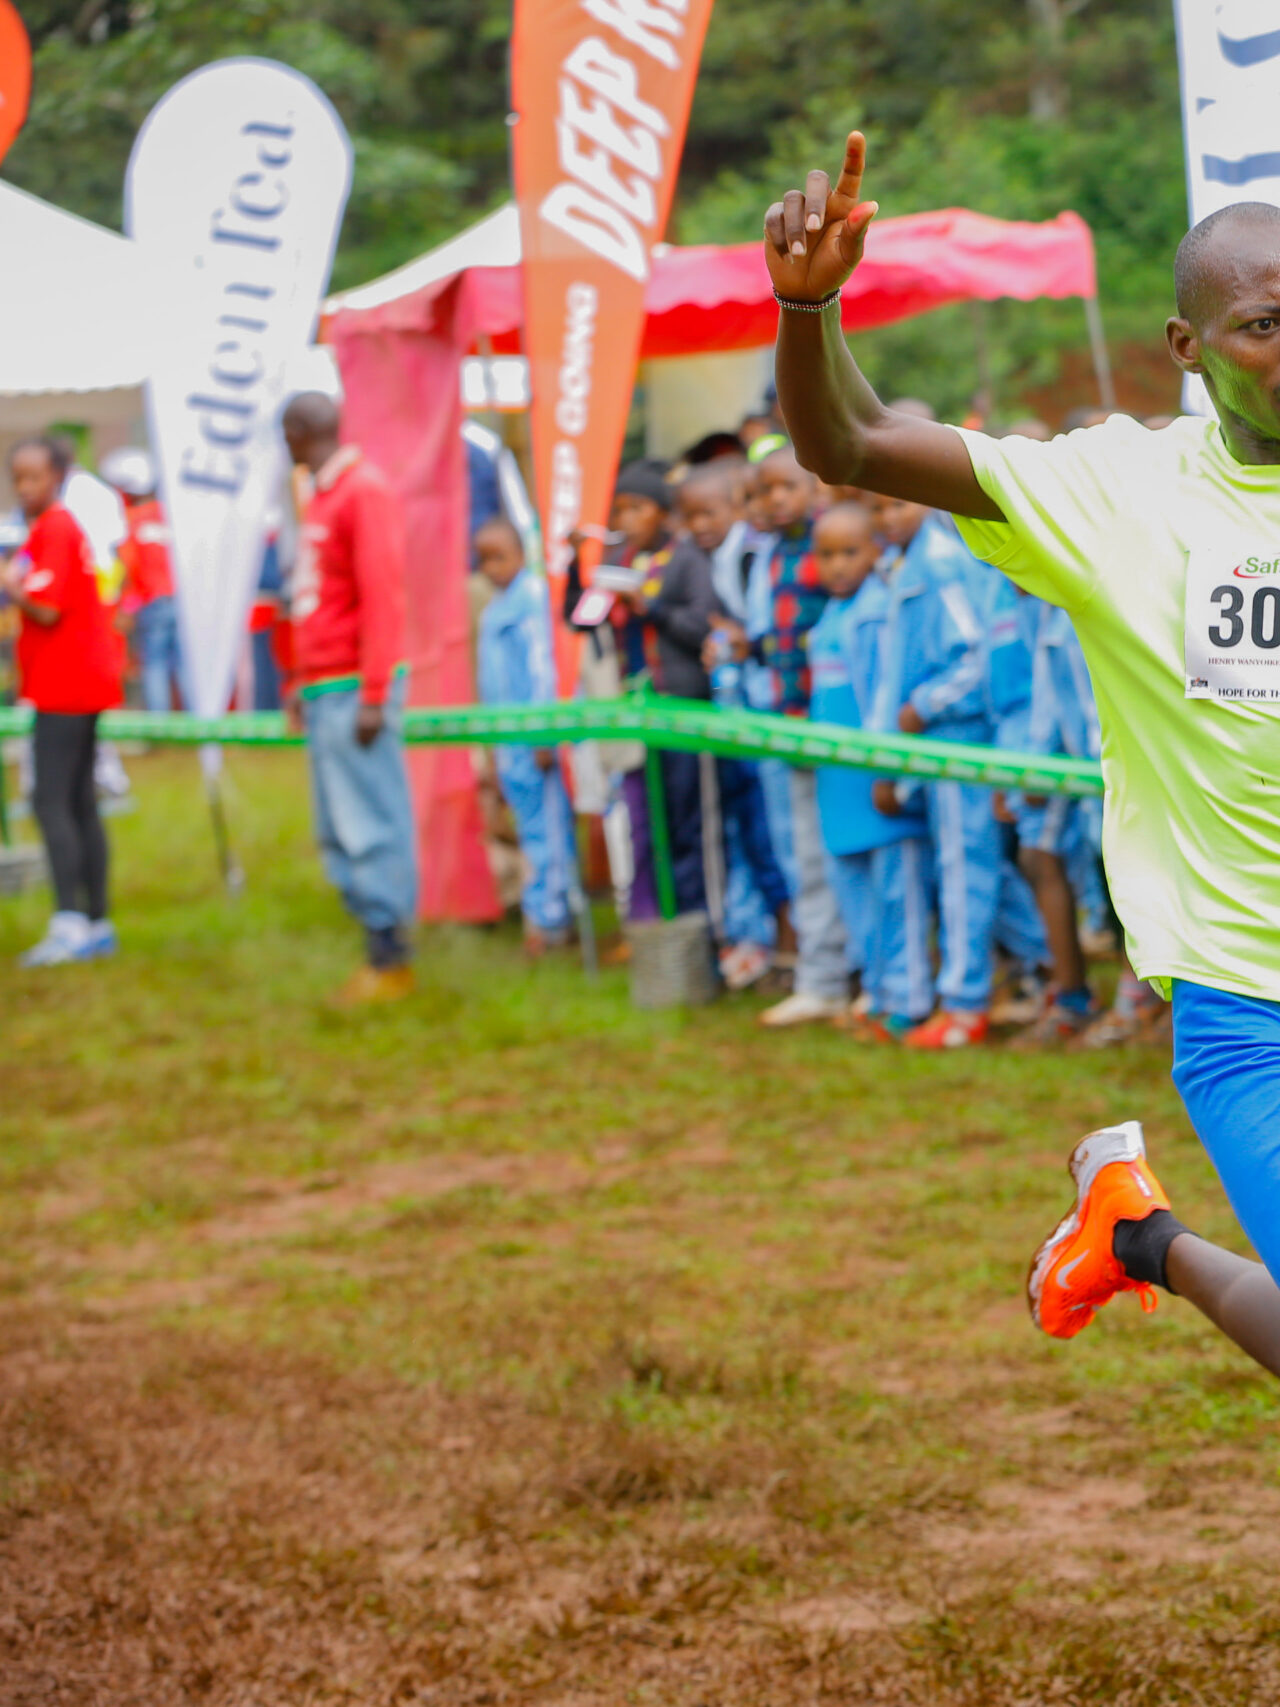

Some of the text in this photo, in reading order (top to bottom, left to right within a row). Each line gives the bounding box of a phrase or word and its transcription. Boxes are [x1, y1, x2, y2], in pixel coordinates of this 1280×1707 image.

[538, 35, 674, 284] DEEP
[178, 118, 296, 497] Eden Tea
[1208, 657, 1236, 666] HENRY
[1218, 687, 1245, 697] HOPE
[1247, 688, 1267, 698] FOR
